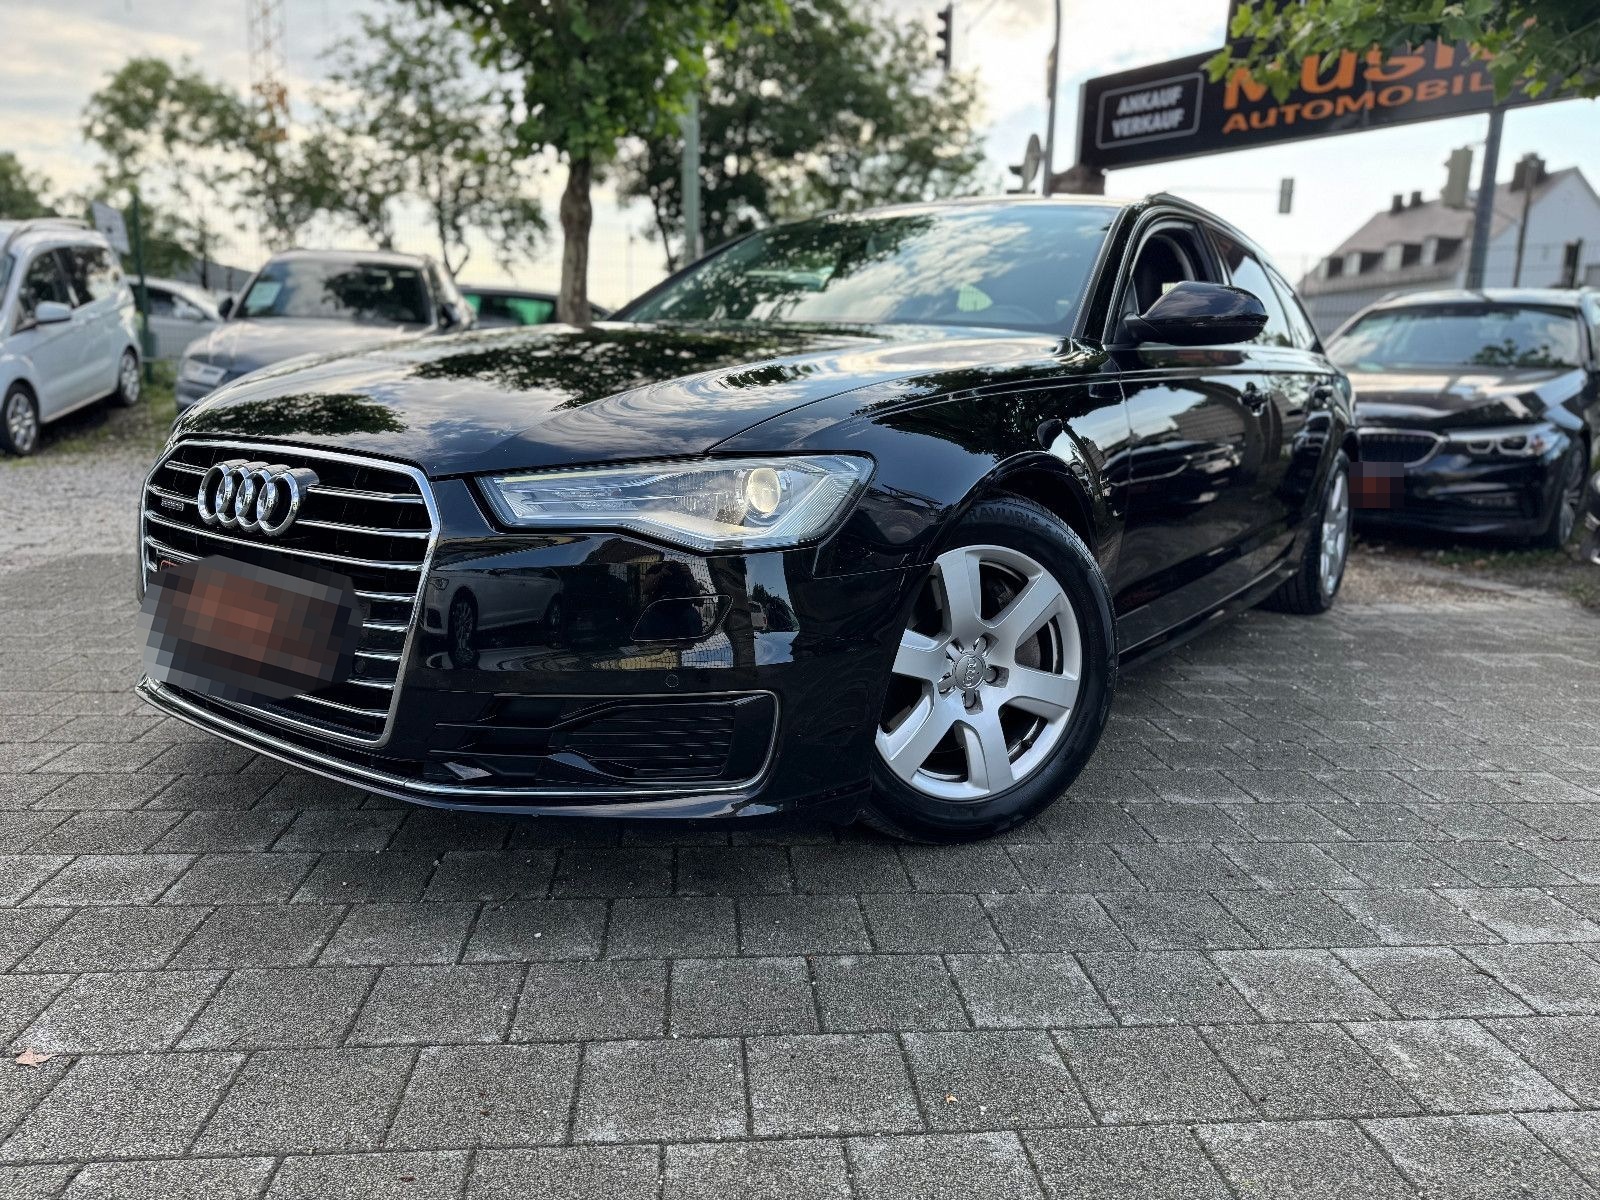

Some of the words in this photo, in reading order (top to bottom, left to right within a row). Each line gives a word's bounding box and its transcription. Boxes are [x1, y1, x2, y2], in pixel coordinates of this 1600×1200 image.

[1116, 85, 1183, 117] ANKAUF
[1222, 71, 1523, 134] AUTOMOBIL
[1111, 107, 1185, 138] VERKAUF
